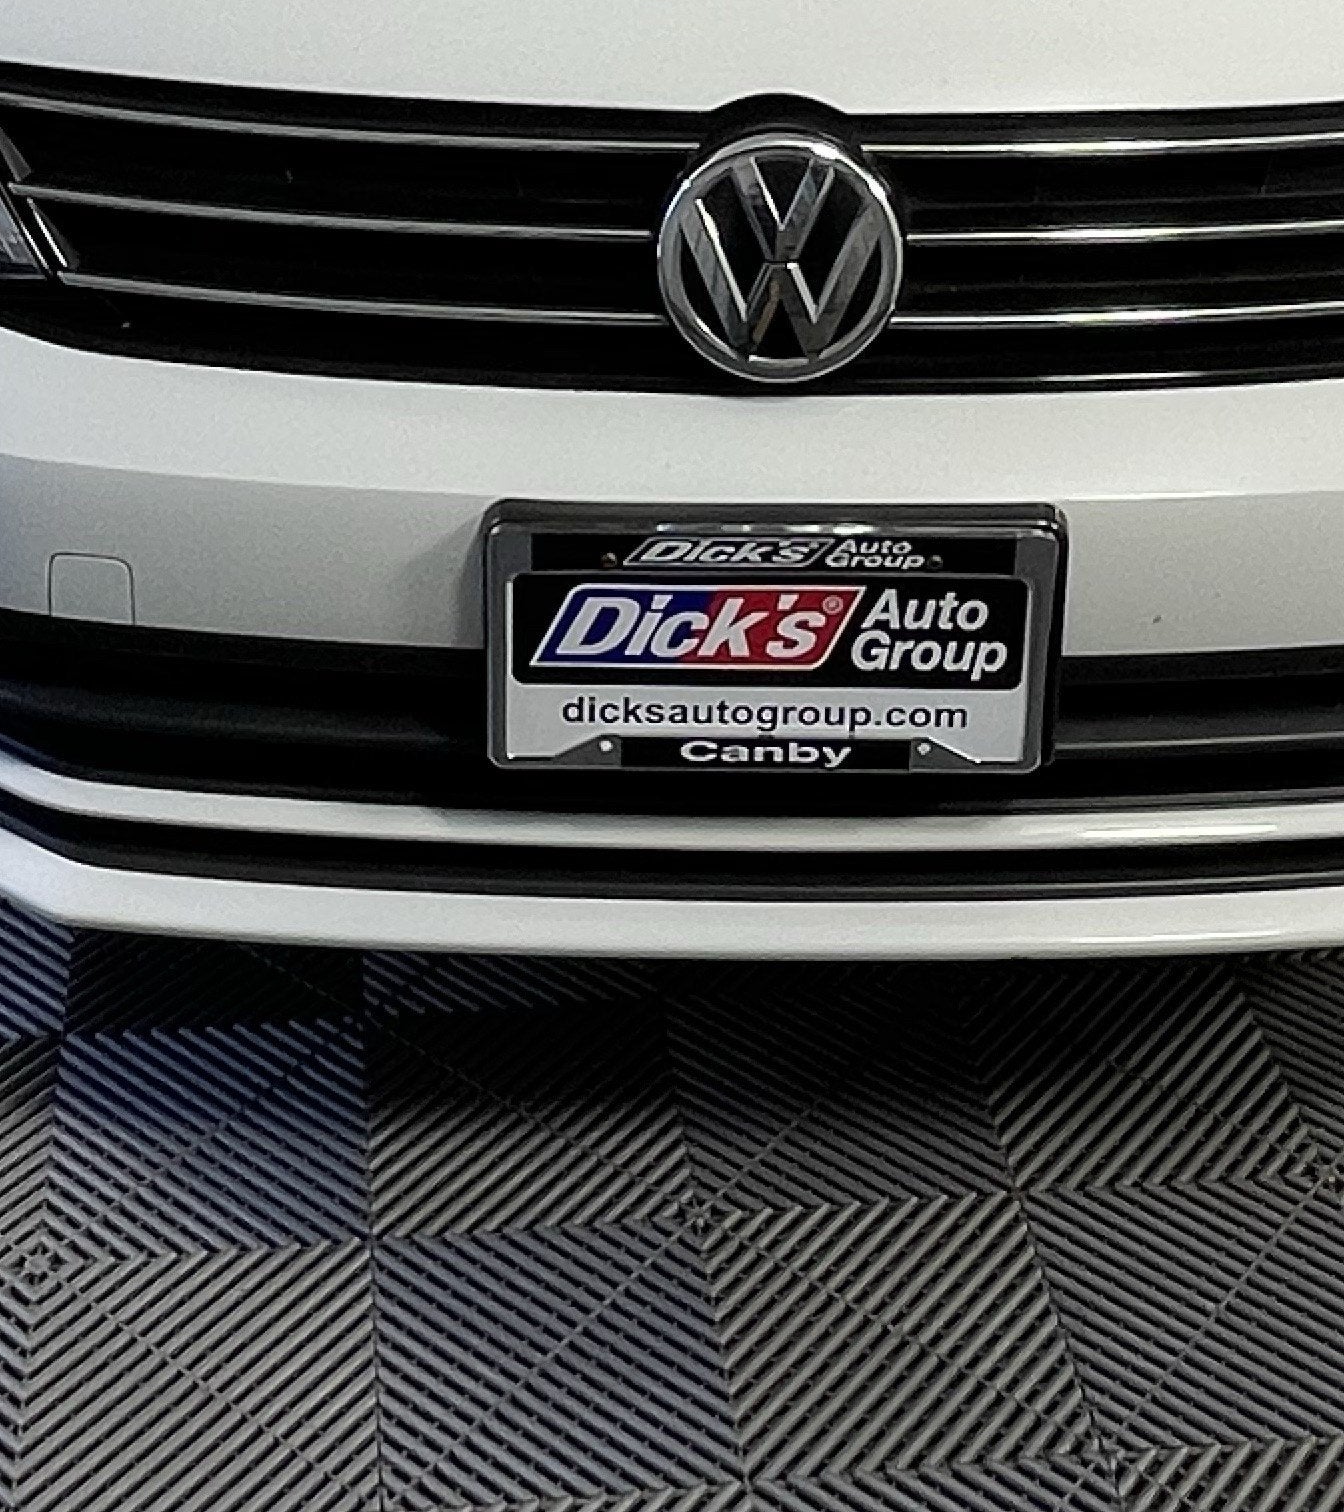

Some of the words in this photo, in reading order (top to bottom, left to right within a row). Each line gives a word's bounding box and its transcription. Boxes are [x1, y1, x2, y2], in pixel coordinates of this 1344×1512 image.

[825, 553, 925, 570] Group
[834, 539, 912, 555] Auto
[862, 589, 988, 630] Auto
[851, 631, 1007, 680] Group
[562, 697, 967, 731] dicksautogroup.com
[680, 740, 852, 768] Canby
